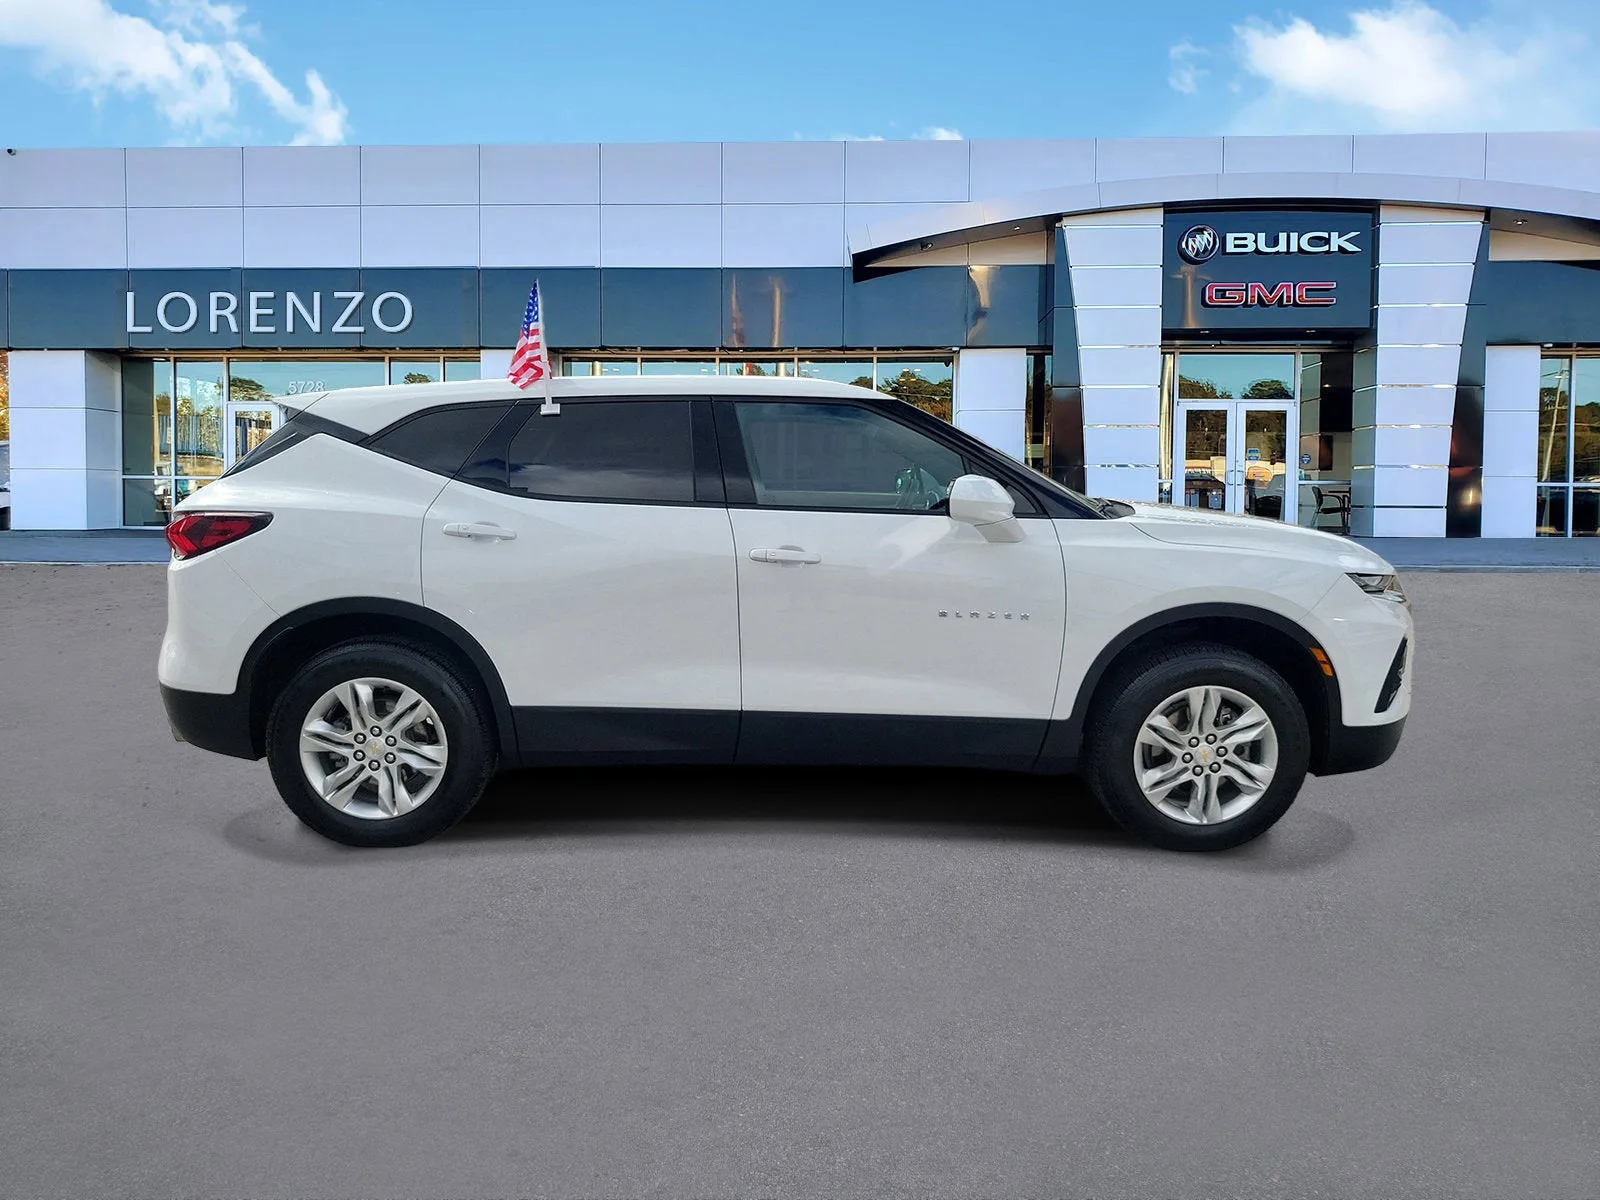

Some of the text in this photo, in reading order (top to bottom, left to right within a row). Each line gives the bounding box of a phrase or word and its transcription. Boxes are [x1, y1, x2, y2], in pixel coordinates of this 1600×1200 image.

[1225, 231, 1362, 253] BUICK
[1204, 281, 1337, 306] GMC
[126, 291, 413, 333] LORENZO
[288, 380, 325, 395] 5728
[938, 609, 1031, 621] BLAZER
